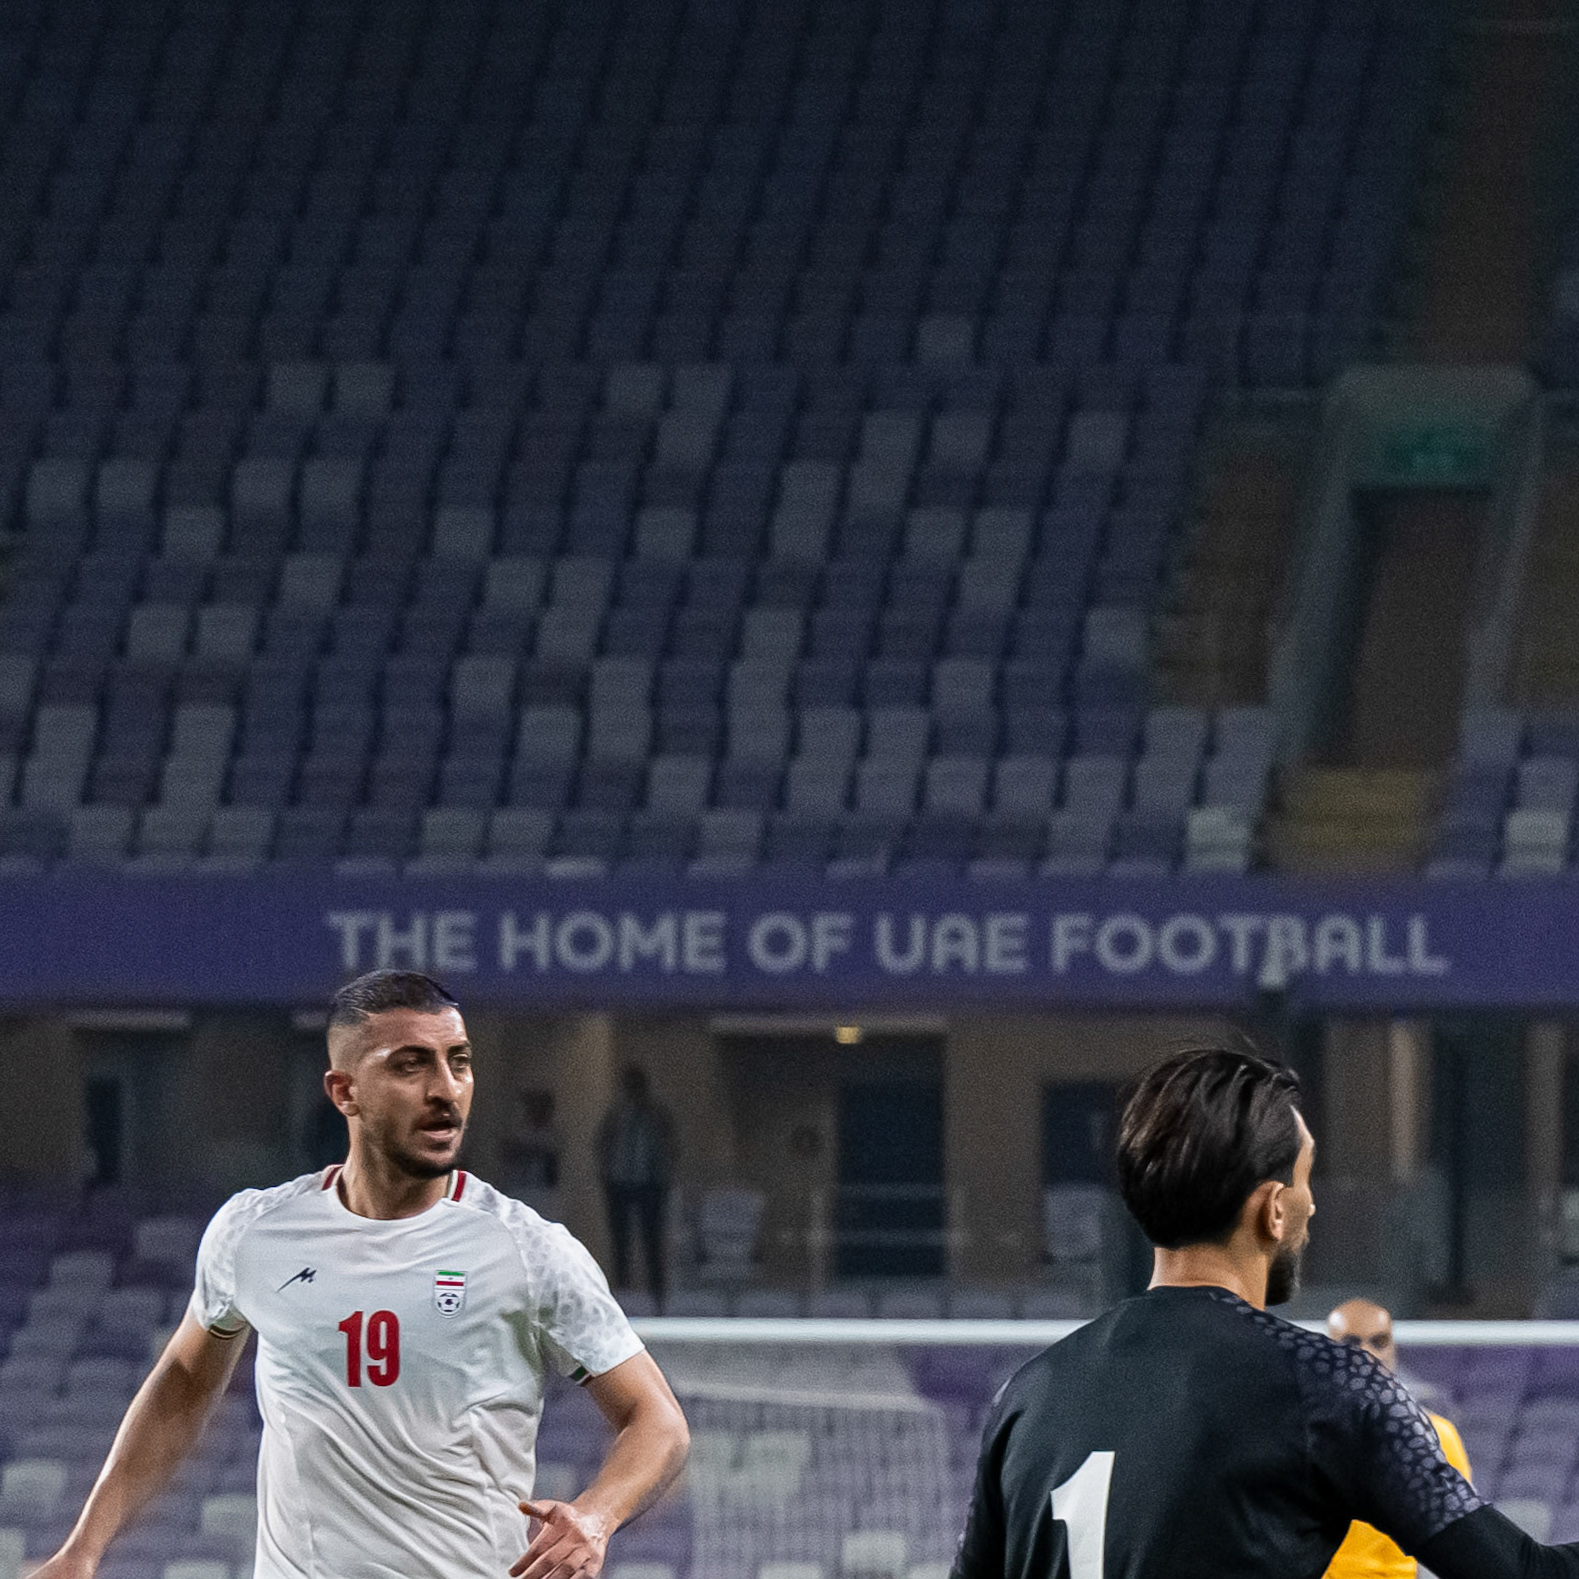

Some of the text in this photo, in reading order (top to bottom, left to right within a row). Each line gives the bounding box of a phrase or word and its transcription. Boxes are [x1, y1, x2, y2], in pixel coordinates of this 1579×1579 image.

[325, 908, 1451, 976] THE HOME OF UAE FOOTBALL
[338, 1309, 400, 1389] 19
